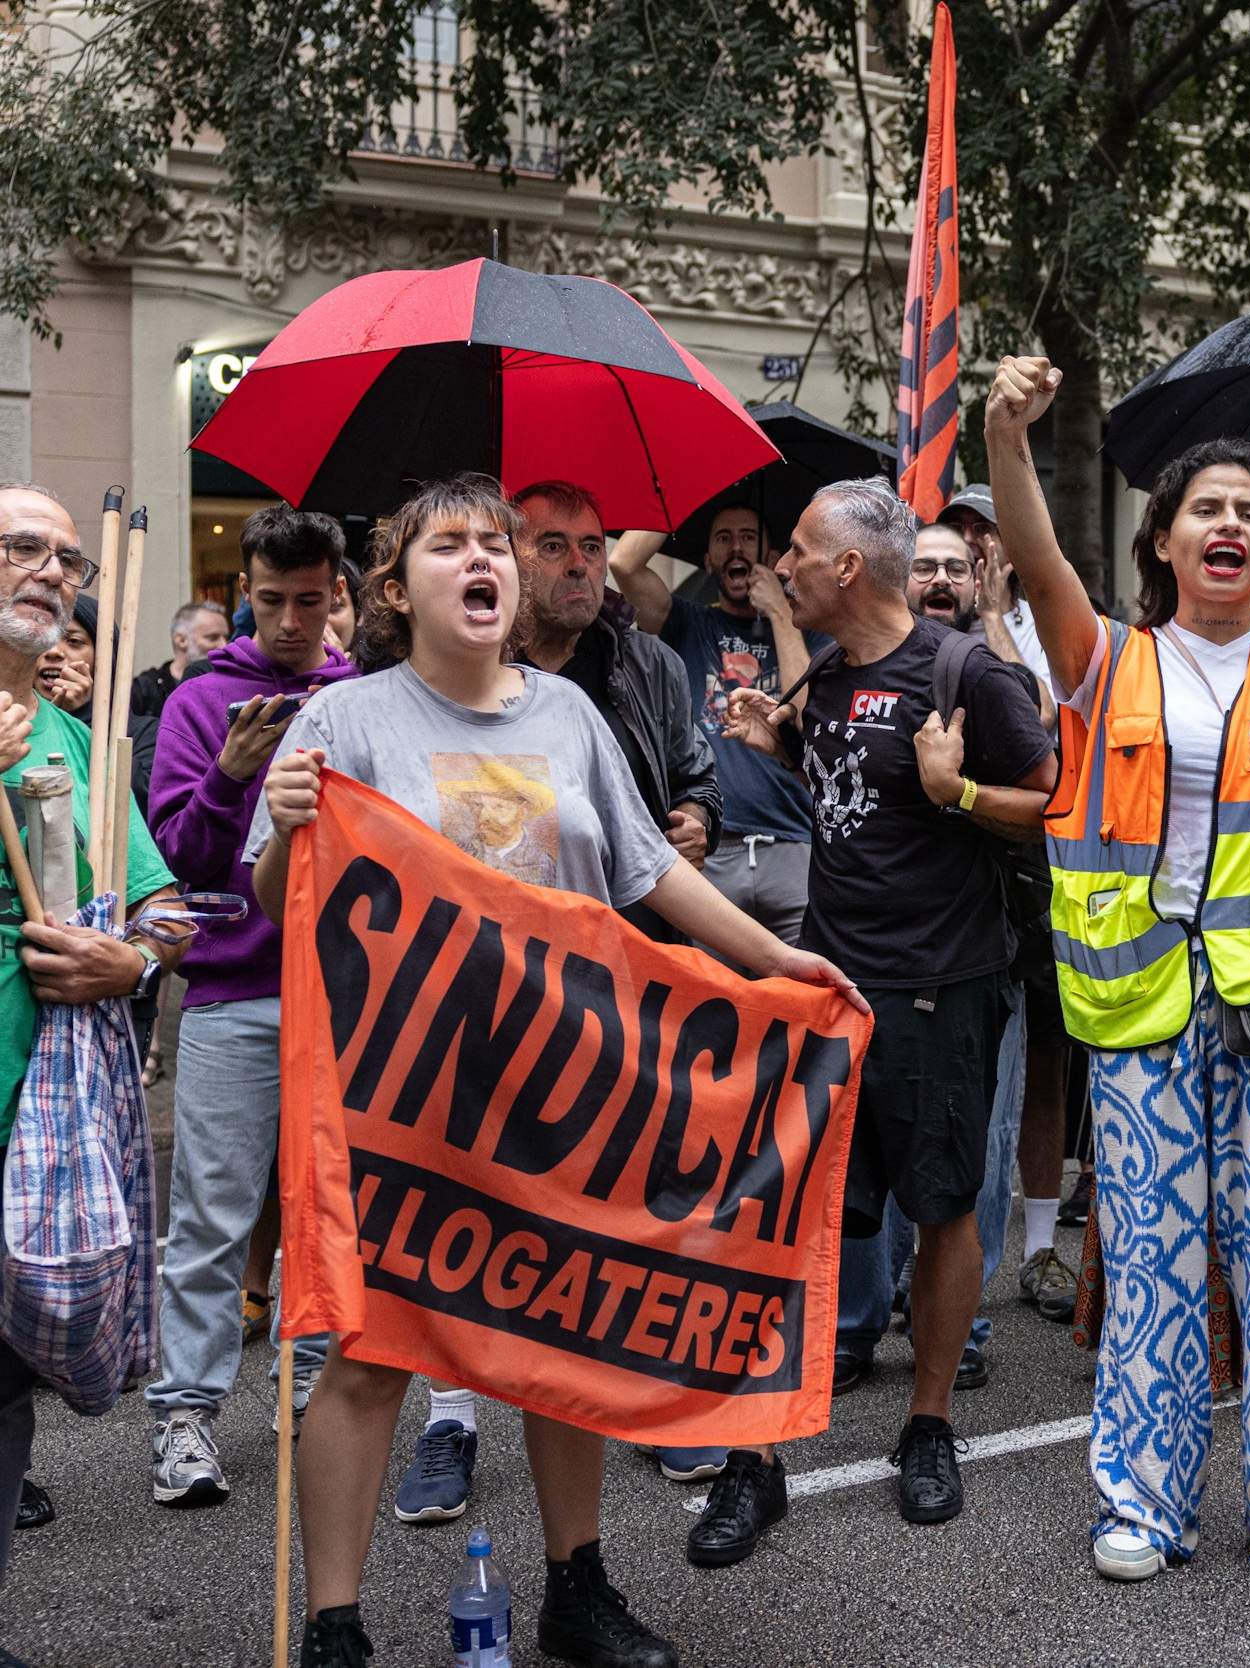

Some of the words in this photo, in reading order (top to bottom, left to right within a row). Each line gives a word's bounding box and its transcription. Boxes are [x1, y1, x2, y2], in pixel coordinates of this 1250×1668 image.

[208, 354, 258, 394] C
[854, 694, 899, 718] CNT
[813, 720, 869, 762] EGAN
[315, 855, 851, 1247] SINDICAT
